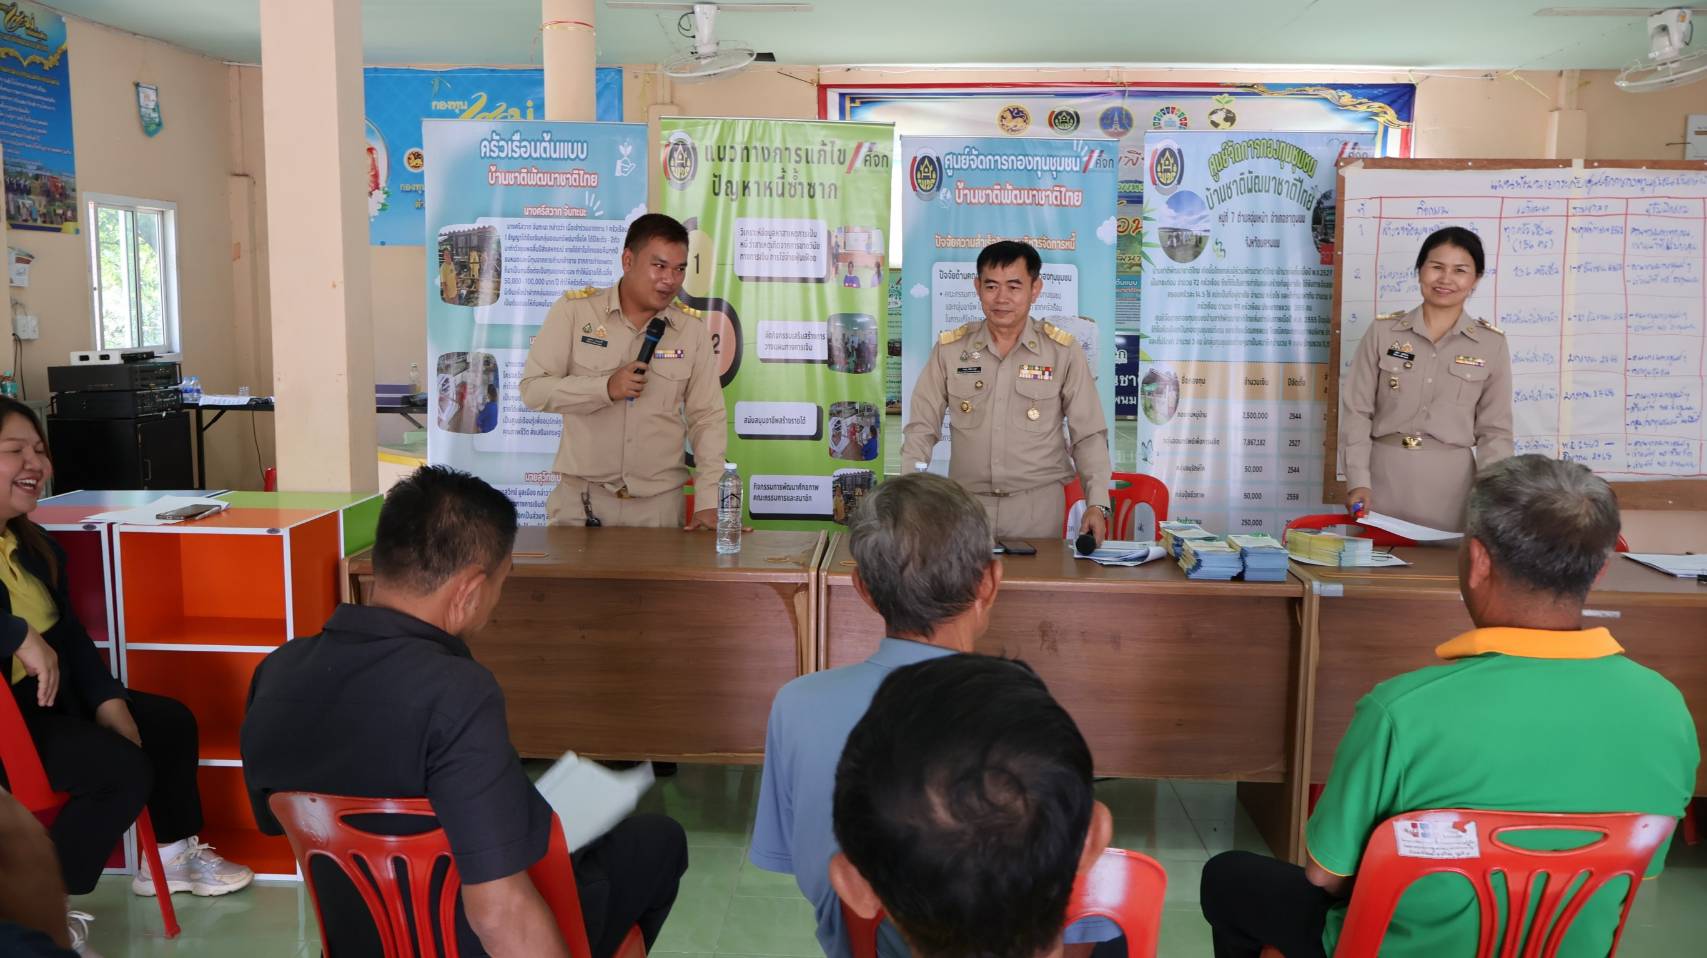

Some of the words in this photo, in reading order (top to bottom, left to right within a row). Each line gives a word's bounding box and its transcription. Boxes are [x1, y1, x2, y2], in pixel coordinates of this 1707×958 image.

[480, 131, 588, 160] ครัวเรือนต้นแบบ
[705, 141, 846, 165] แนวทางการแก้ไข
[944, 147, 1081, 179] ศูนย์จัดการกองทุนชุมชน
[1208, 138, 1318, 183] ศูนย์จัดการกองทุนชุมชน
[400, 183, 425, 194] กองทุ
[488, 164, 599, 187] บ้านชาติพัฒนาชาติไทย
[712, 168, 838, 201] ปัญหาหนี้ซ้ำซาก
[955, 181, 1083, 207] บ้านชาติพัฒนาชาติไทย
[1205, 169, 1316, 211] บ้านชาติพัฒนาชาติไทย
[694, 254, 700, 274] 1
[711, 334, 721, 355] 2
